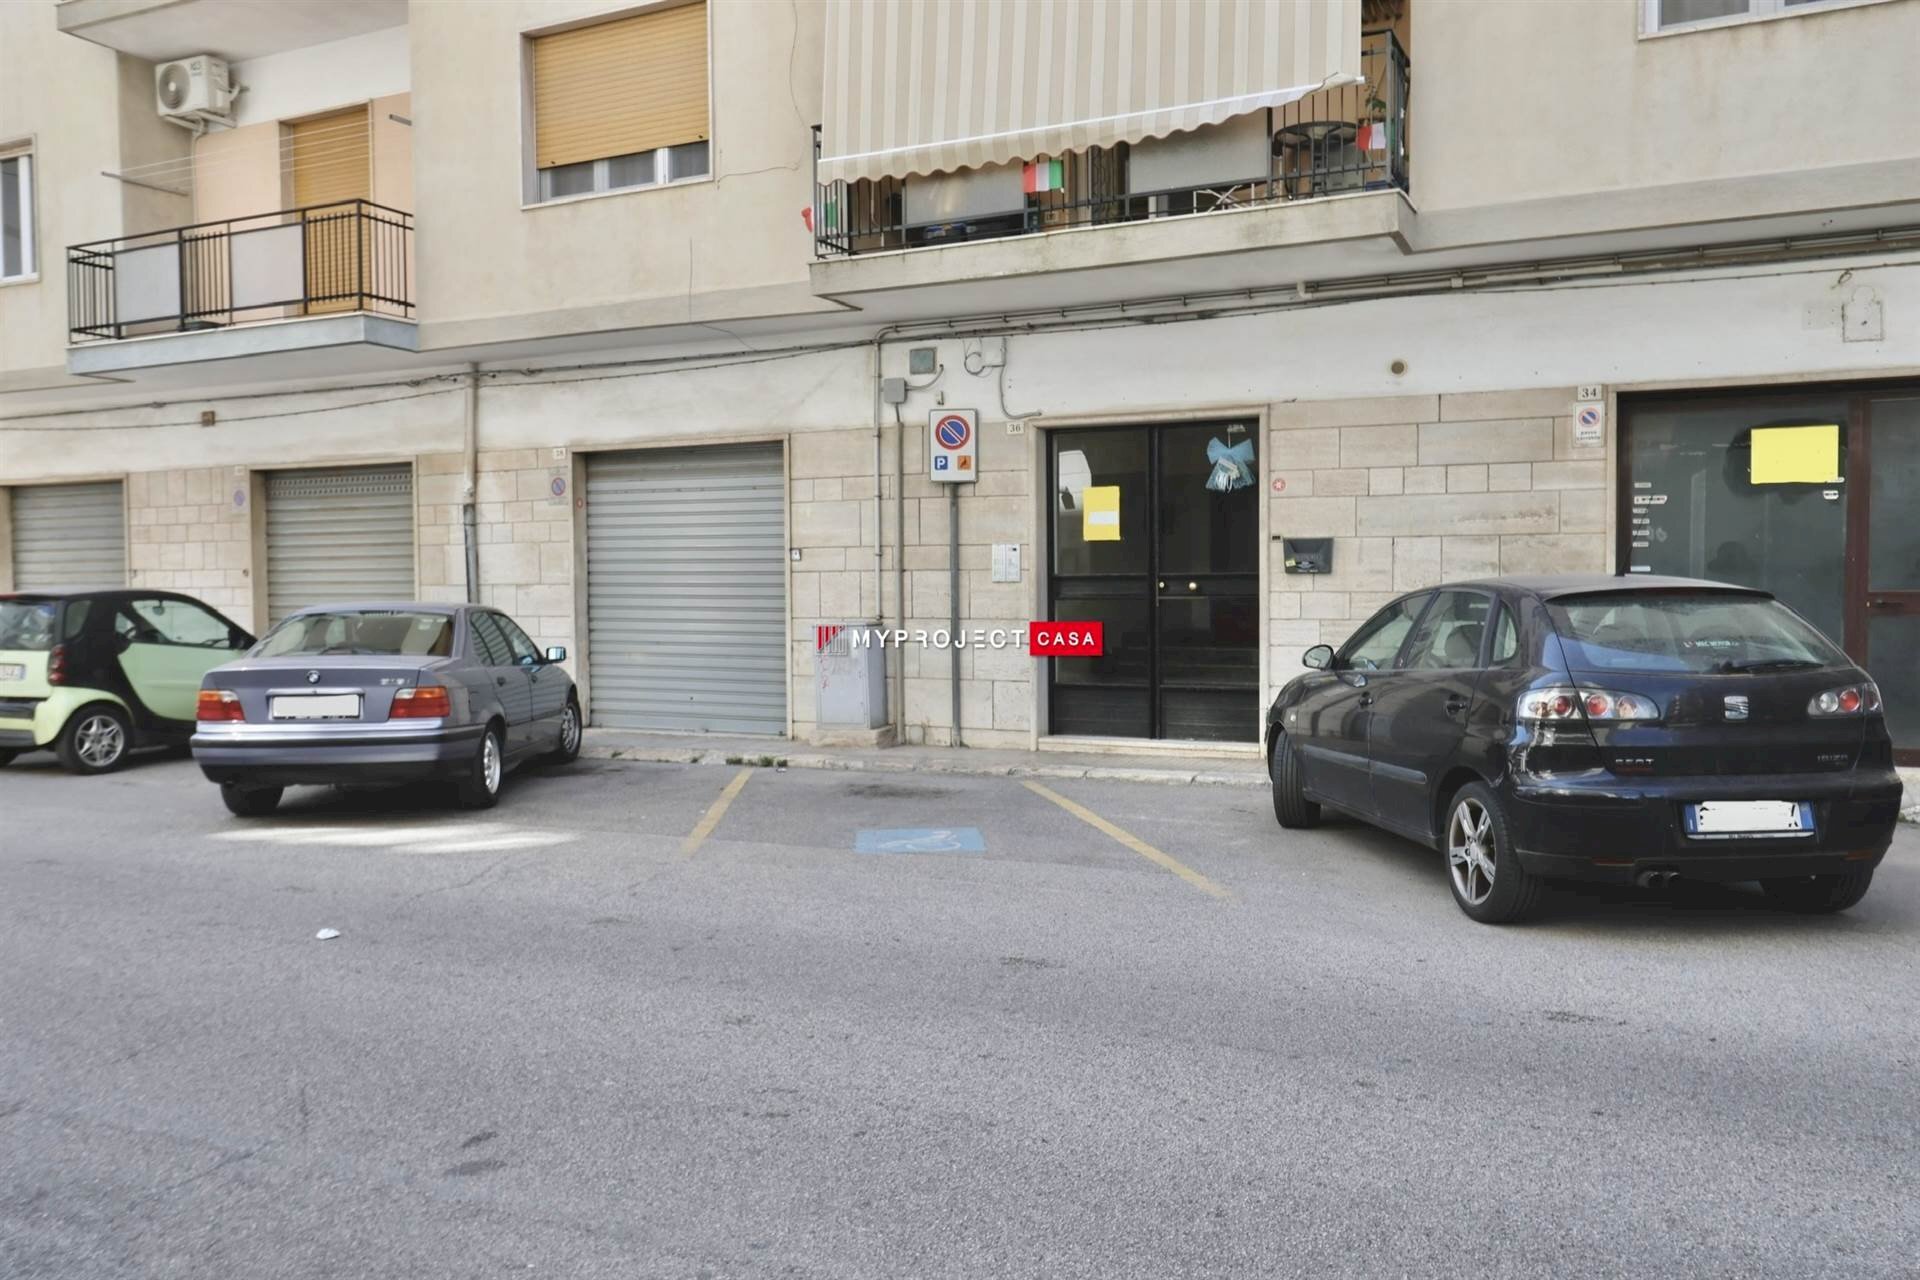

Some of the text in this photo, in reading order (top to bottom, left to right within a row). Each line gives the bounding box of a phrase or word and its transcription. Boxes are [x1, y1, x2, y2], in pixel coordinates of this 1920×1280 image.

[1582, 387, 1597, 398] 34
[1009, 424, 1021, 433] 36
[937, 457, 946, 469] P
